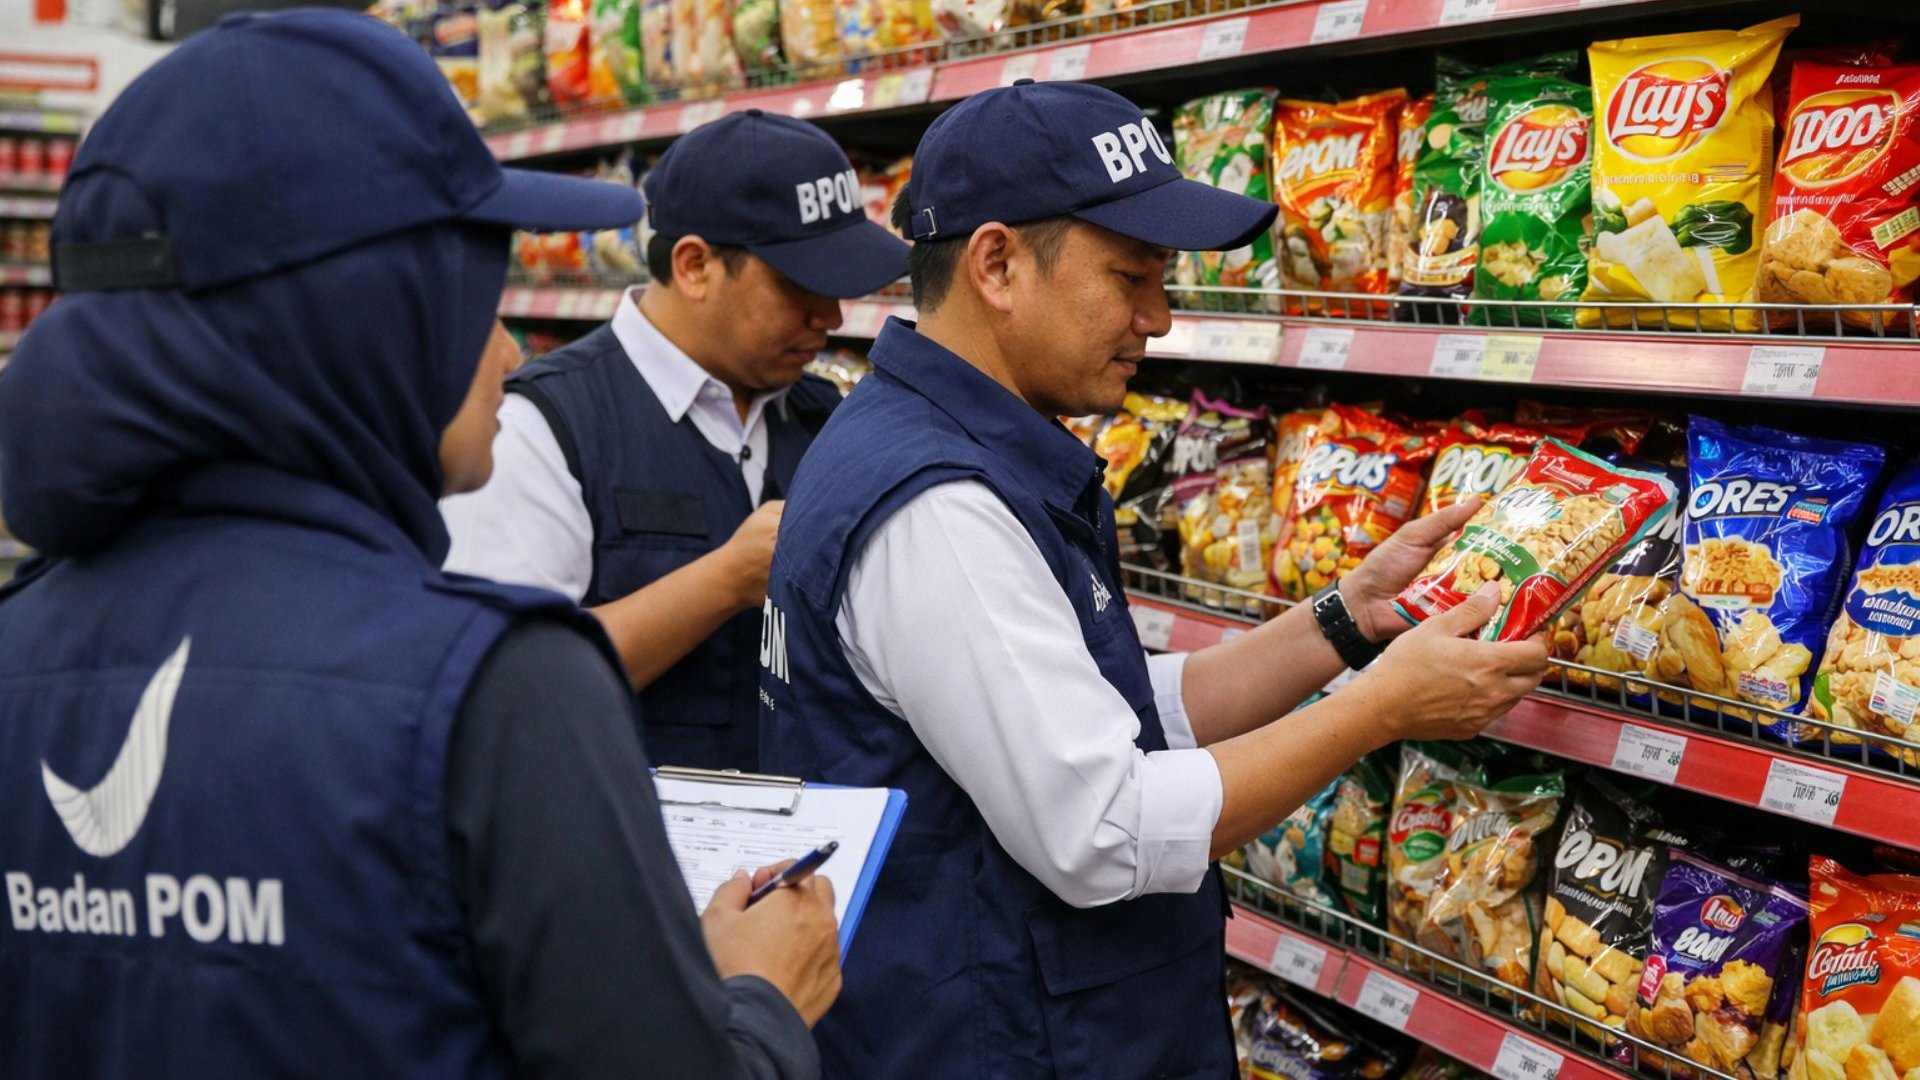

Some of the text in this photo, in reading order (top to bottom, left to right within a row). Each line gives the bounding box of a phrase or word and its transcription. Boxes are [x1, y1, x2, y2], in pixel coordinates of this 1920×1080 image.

[1611, 78, 1719, 138] Lays
[1091, 116, 1177, 184] BPO
[1491, 122, 1584, 174] Lays
[1687, 480, 1797, 519] ORES
[5, 872, 285, 946] Badan POM
